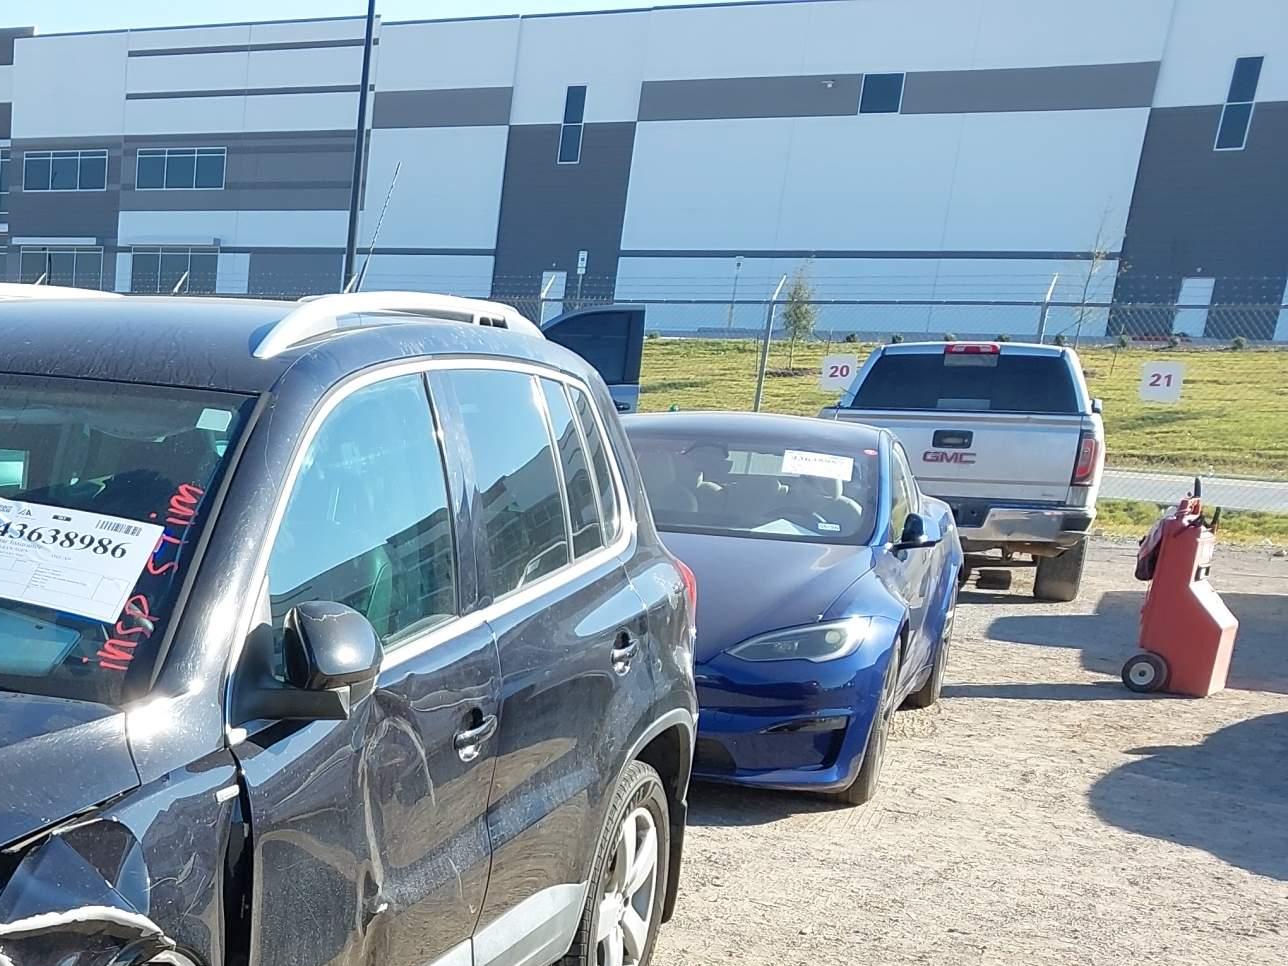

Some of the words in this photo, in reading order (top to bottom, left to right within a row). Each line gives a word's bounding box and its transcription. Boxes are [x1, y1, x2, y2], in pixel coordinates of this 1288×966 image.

[828, 364, 851, 378] 20
[1148, 373, 1174, 388] 21
[922, 450, 977, 464] GMC
